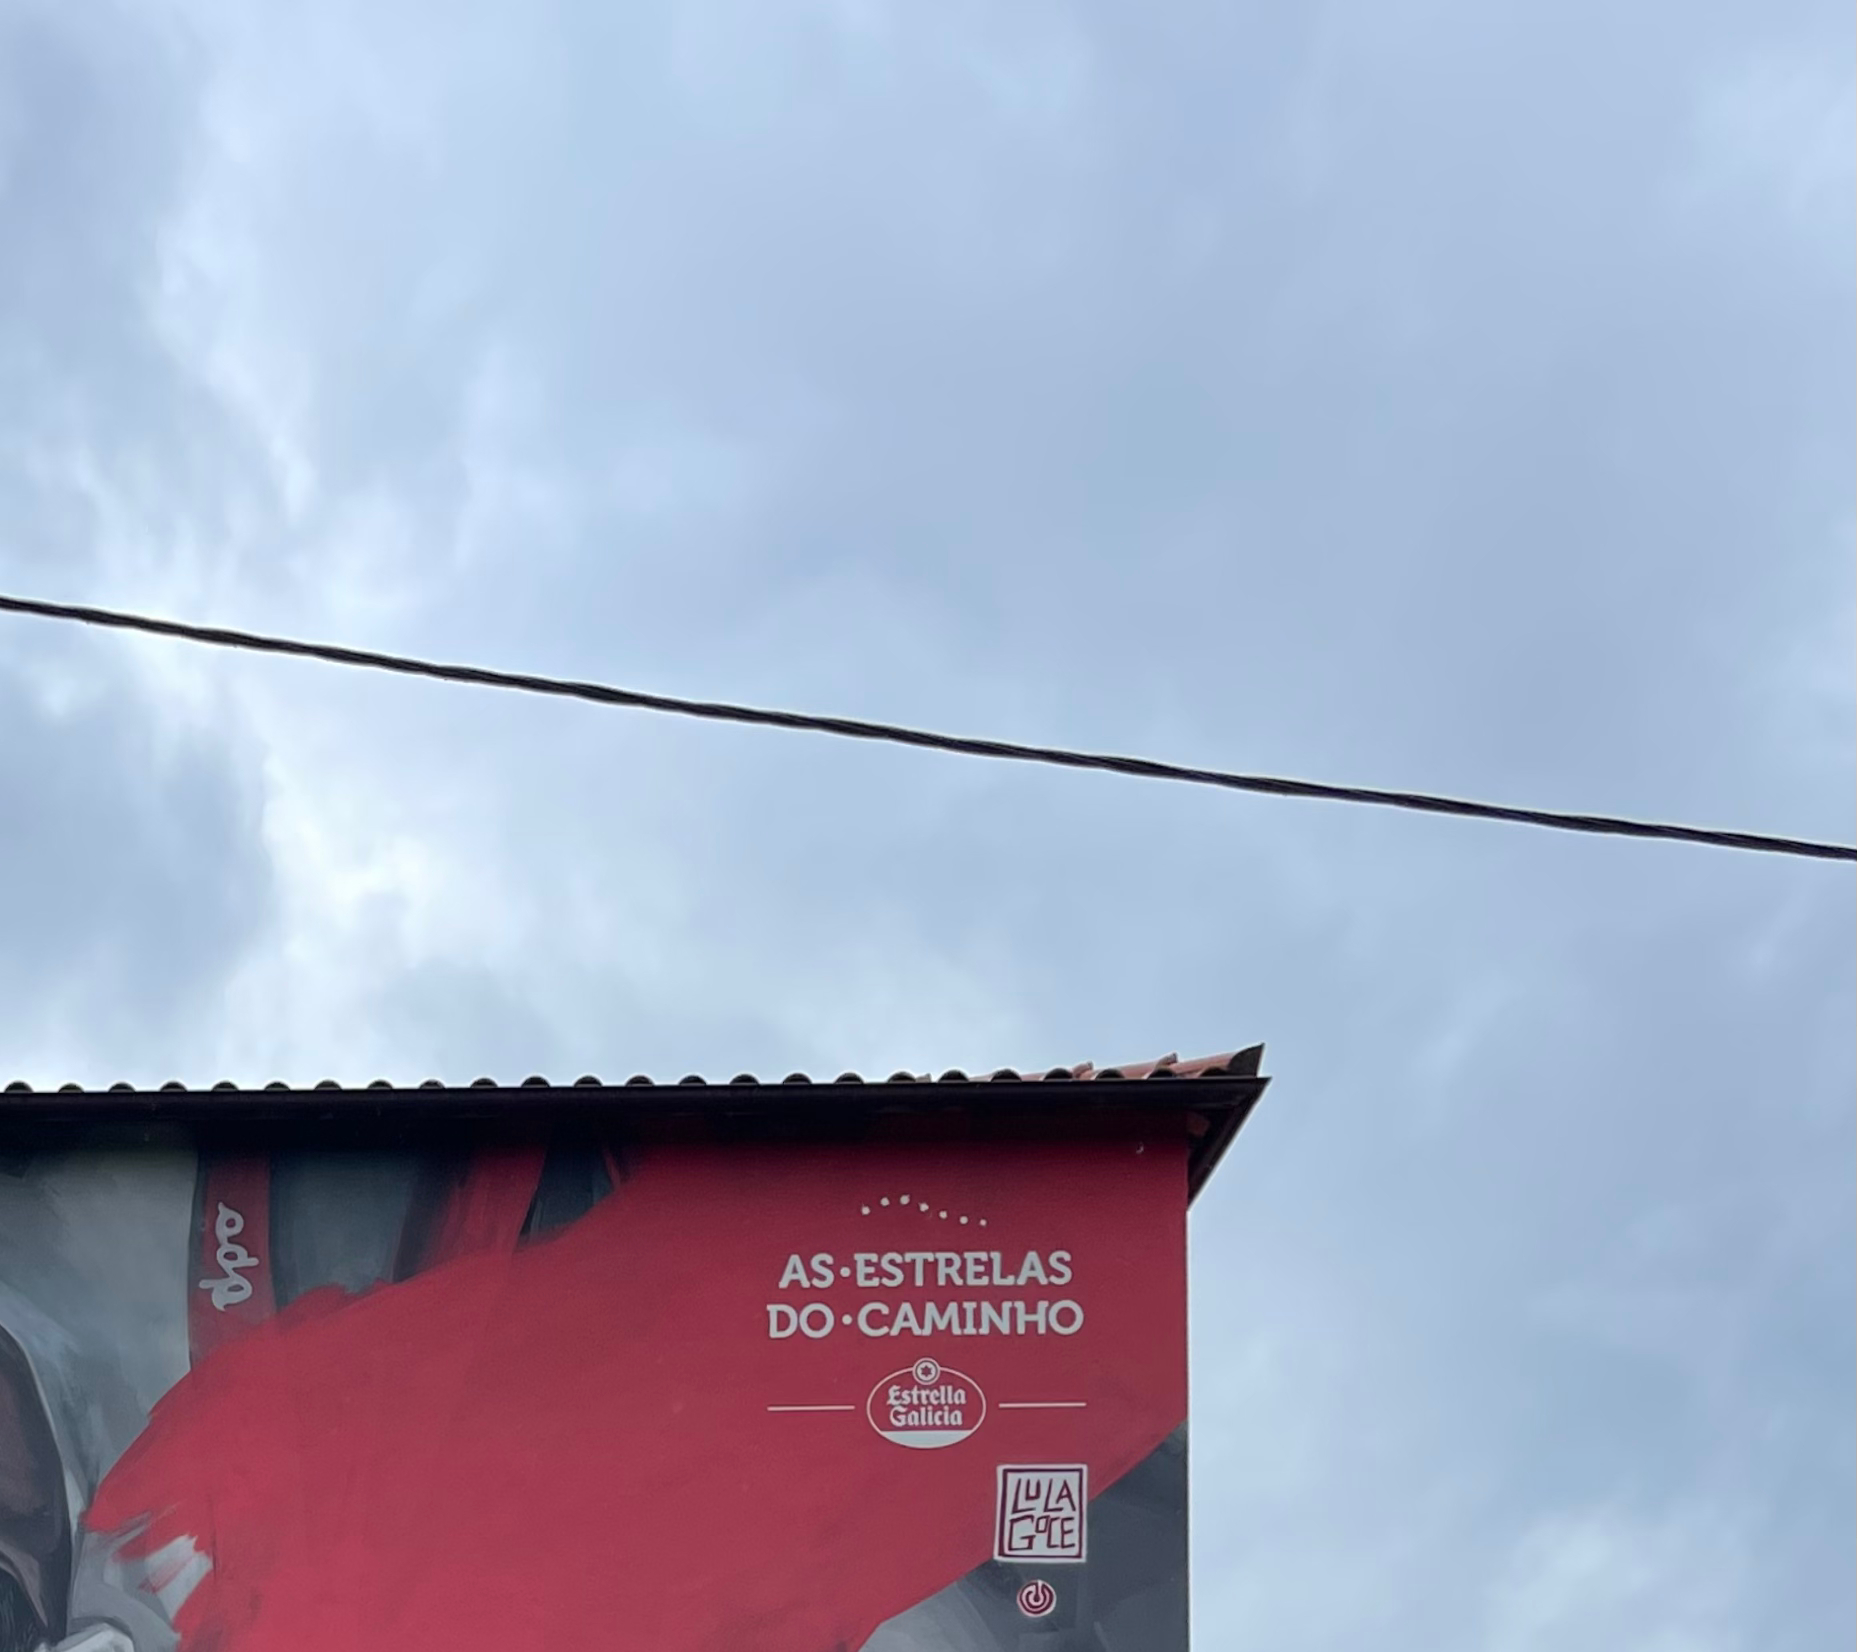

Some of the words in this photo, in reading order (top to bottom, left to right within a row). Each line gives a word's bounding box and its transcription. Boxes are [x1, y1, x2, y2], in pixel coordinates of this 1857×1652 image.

[886, 1385, 967, 1406] Estrella
[889, 1406, 963, 1427] Galicia
[1011, 1478, 1076, 1514] LULA
[1008, 1514, 1076, 1551] GOCE
